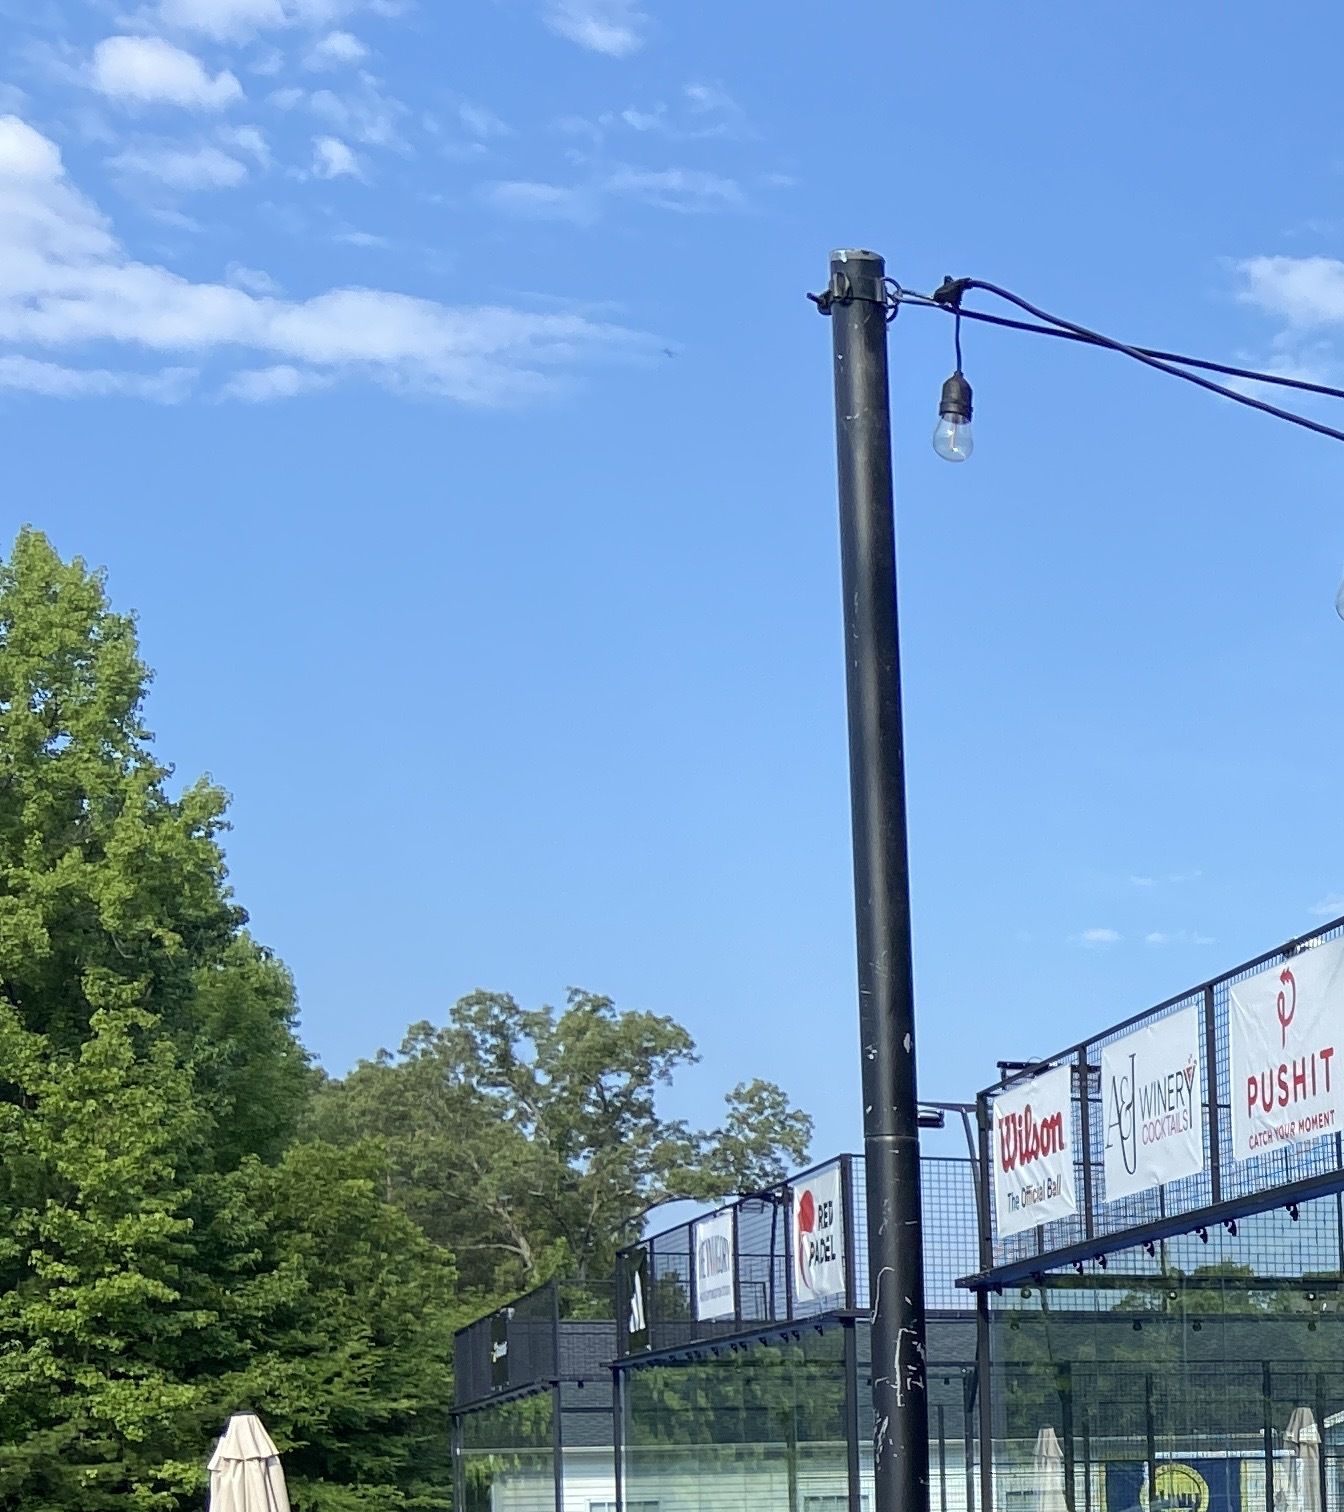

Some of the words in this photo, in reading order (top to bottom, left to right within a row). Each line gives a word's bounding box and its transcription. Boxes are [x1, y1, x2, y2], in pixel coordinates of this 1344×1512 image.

[1138, 1064, 1197, 1130] WINERY
[1246, 1046, 1335, 1120] PUSHIT
[998, 1103, 1065, 1174] Wilson
[1141, 1108, 1189, 1146] COCKTAILS
[1248, 1127, 1274, 1151] CATCH
[1273, 1121, 1296, 1142] YOUR
[1298, 1108, 1336, 1134] MOMENT
[1007, 1191, 1020, 1213] The
[1046, 1173, 1062, 1200] Ball
[817, 1200, 834, 1232] RED
[808, 1234, 837, 1268] PADEL
